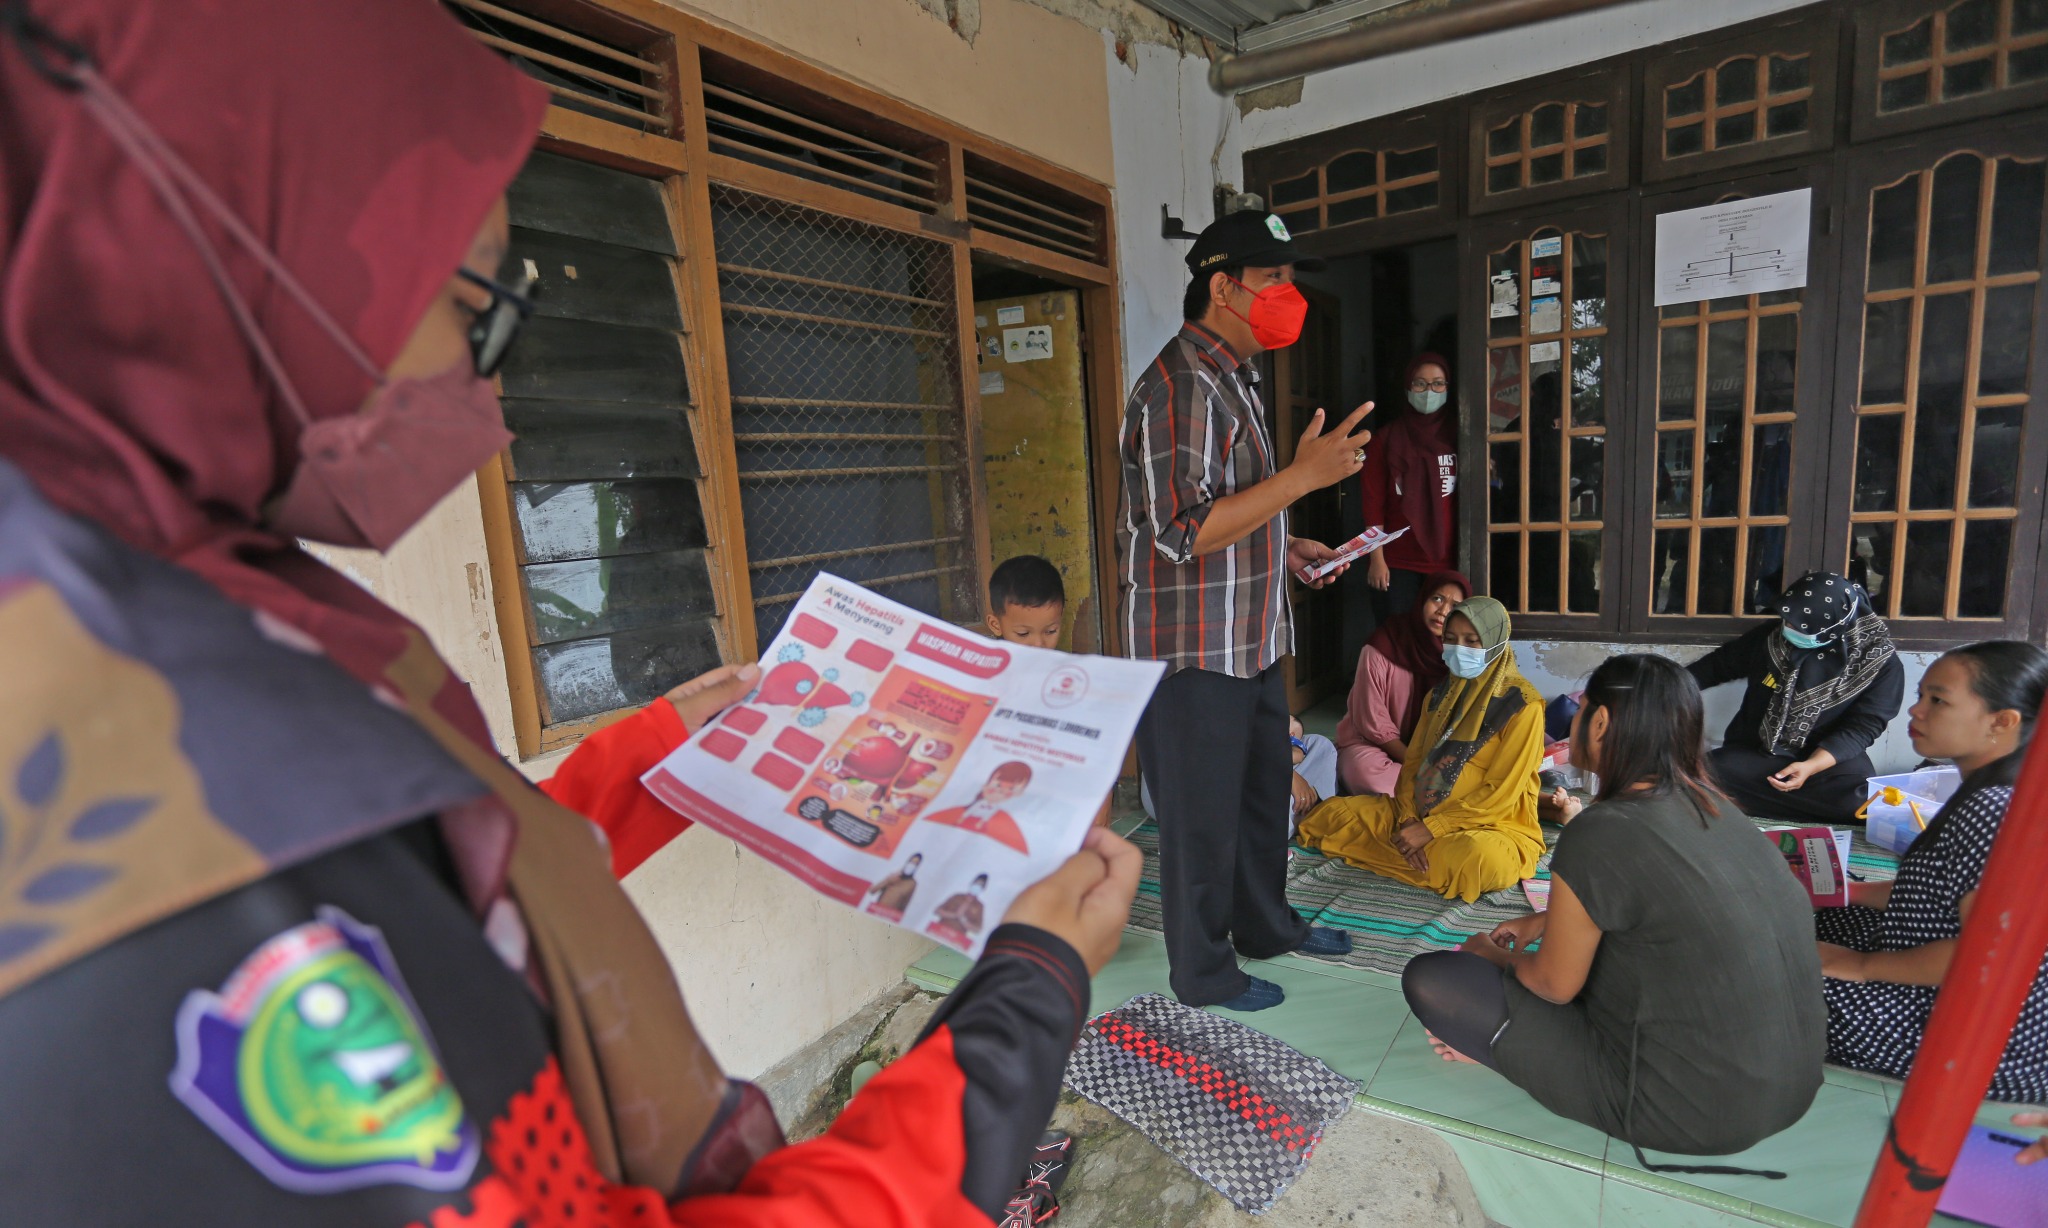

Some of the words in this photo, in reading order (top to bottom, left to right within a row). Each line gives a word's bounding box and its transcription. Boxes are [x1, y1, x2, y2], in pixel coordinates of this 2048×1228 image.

[823, 597, 832, 607] A
[834, 602, 894, 635] Menyerang
[824, 586, 854, 604] Awas
[856, 599, 905, 626] Hepatitis
[917, 632, 962, 659] WASPADA
[960, 648, 1003, 669] HEPATITIS
